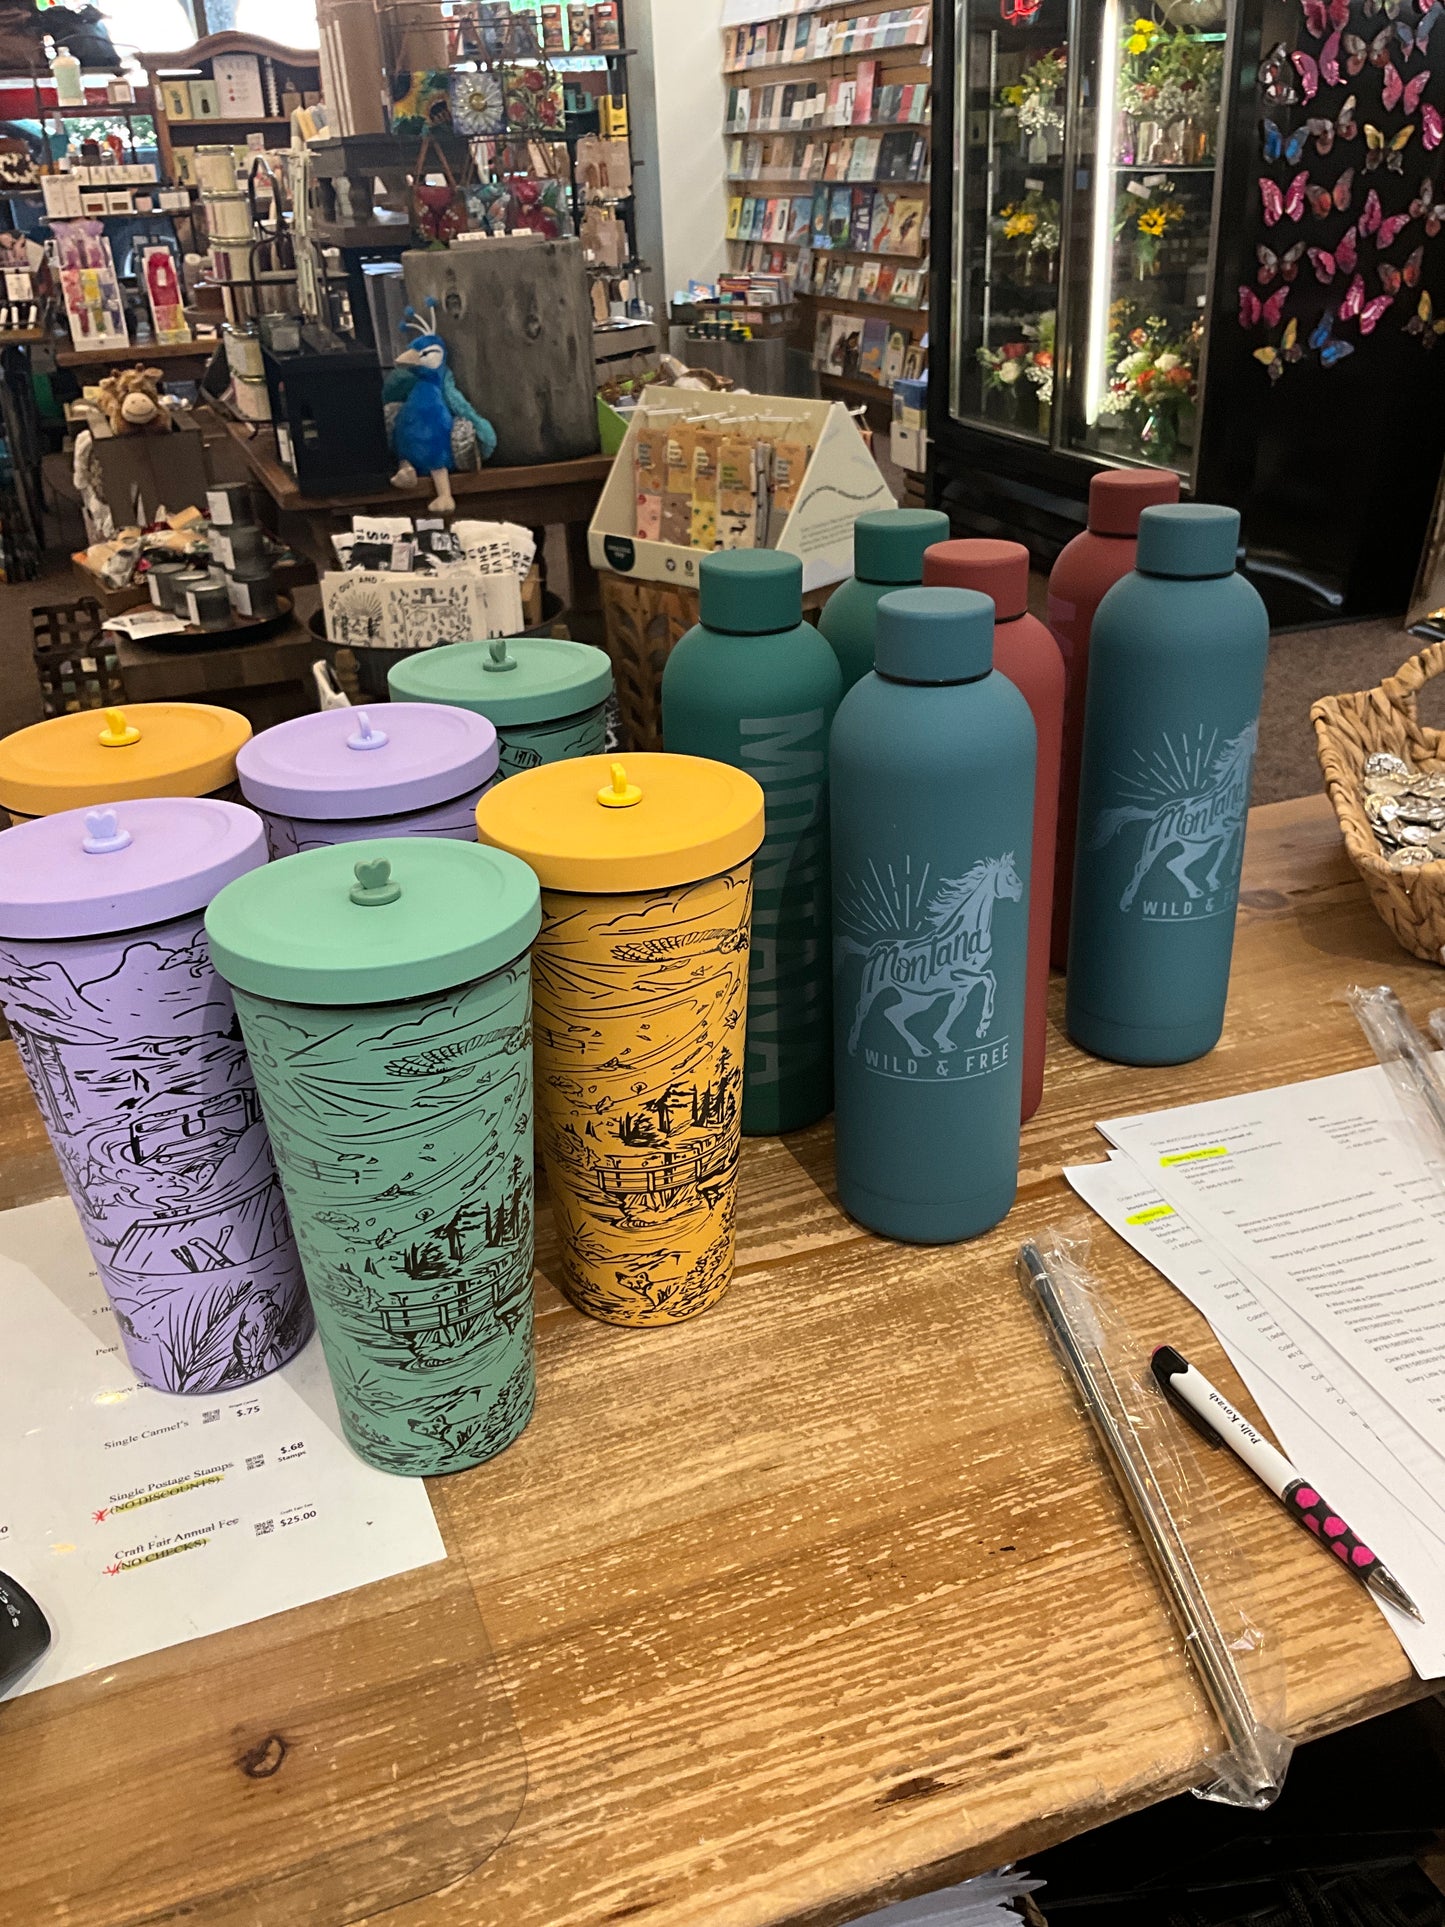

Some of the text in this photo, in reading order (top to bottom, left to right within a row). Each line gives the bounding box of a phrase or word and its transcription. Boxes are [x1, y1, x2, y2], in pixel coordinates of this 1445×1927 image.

[359, 576, 378, 584] AND
[1143, 901, 1192, 916] WILD
[866, 929, 992, 993] Montana
[865, 1043, 1009, 1077] WILD & FREE
[95, 1345, 119, 1356] Pens
[236, 1405, 260, 1418] $.75
[104, 1420, 189, 1450] Single Carmel's
[1239, 1423, 1262, 1444] Polly
[278, 1450, 306, 1463] Stamps
[280, 1441, 304, 1454] $.68
[109, 1462, 235, 1503] Single Postage Stamps
[110, 1475, 220, 1515] (NO DISCOUNTS)
[280, 1510, 317, 1527] $25.00
[115, 1517, 239, 1560] Craft Fair Annual Fee
[116, 1538, 208, 1572] (NO CHECKS)
